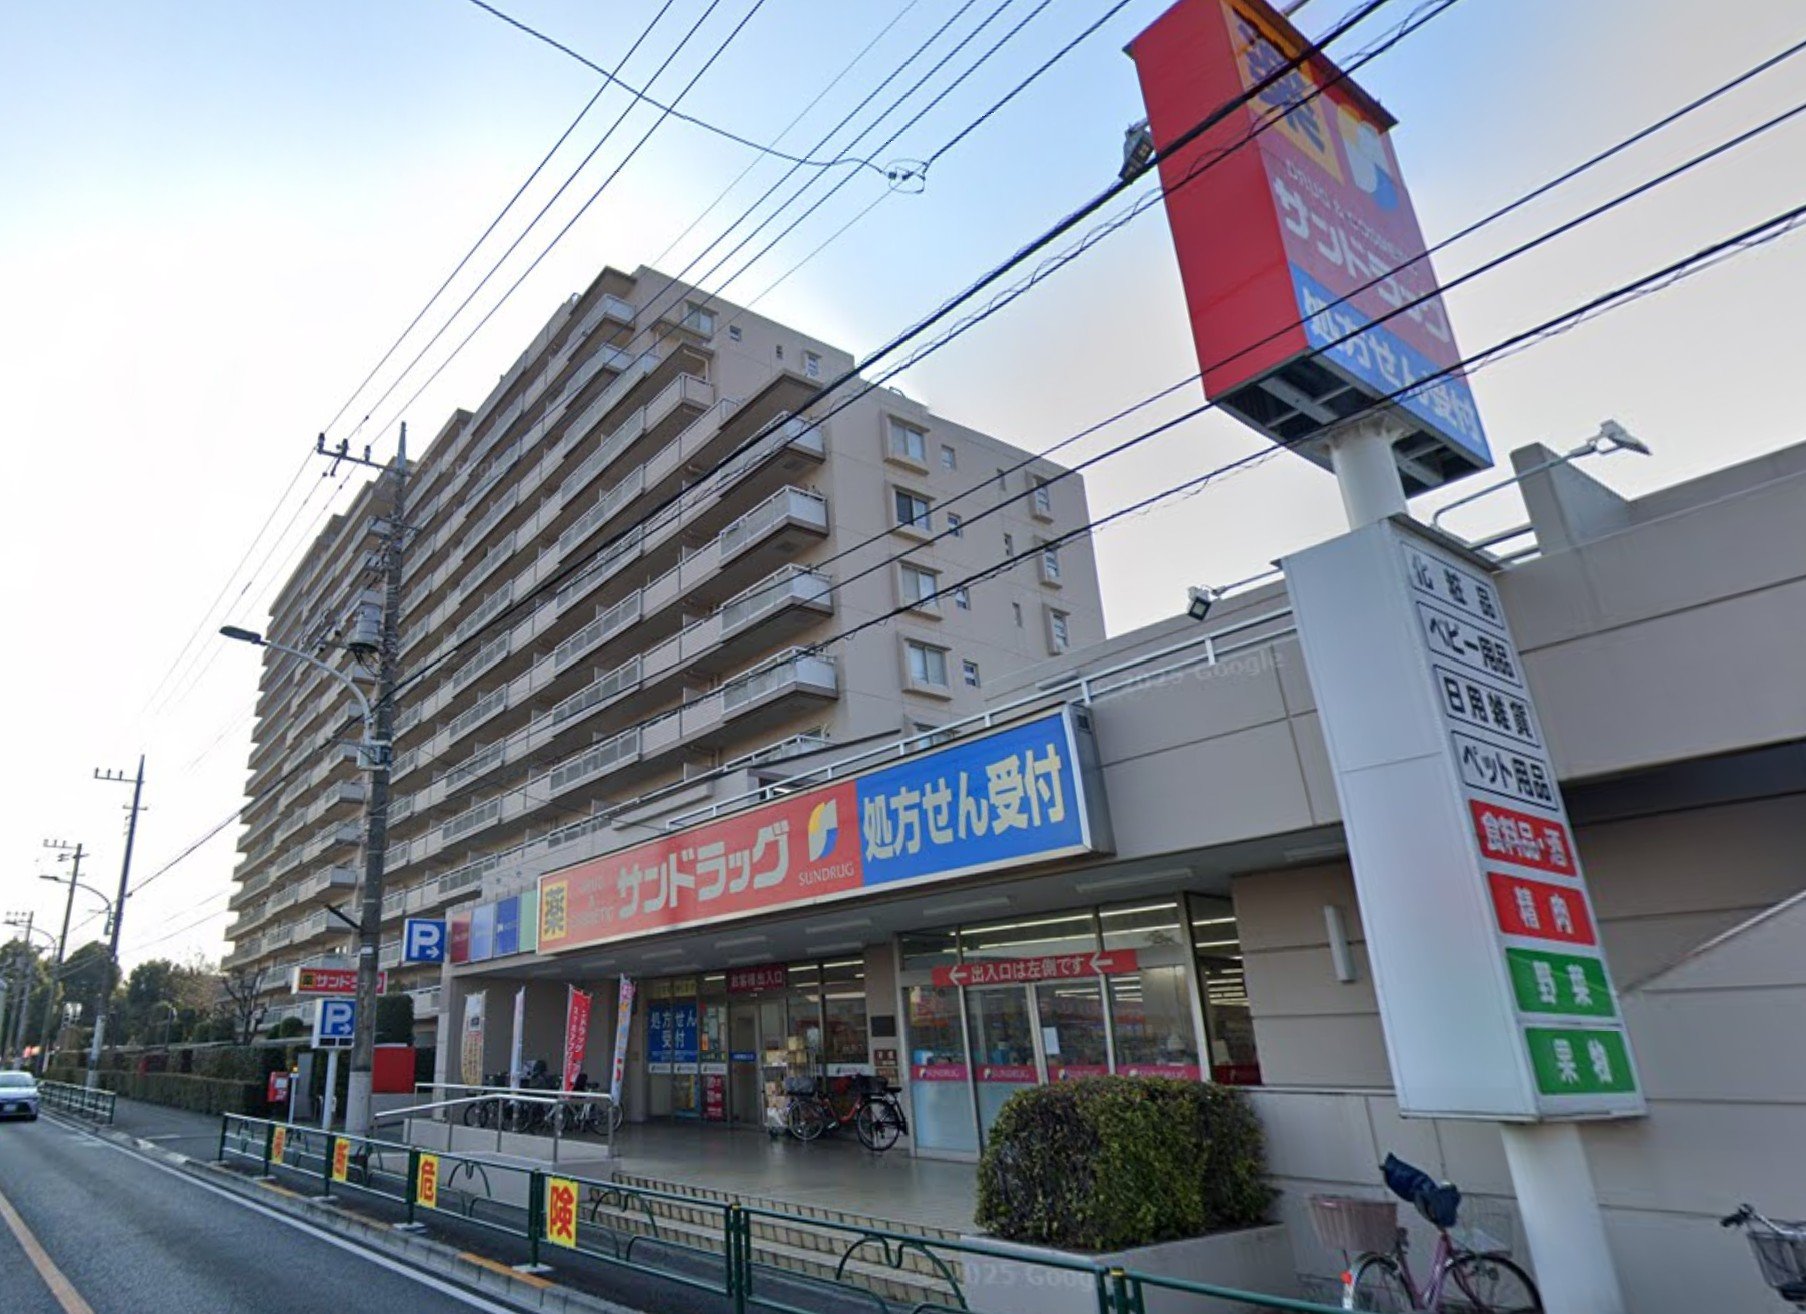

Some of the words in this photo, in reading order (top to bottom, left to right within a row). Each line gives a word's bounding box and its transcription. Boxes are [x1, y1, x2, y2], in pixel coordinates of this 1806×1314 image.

[1272, 174, 1451, 343] サンドラッグ
[1429, 616, 1515, 679] ベビー用品
[1462, 744, 1552, 801] ペット用品
[862, 743, 1066, 863] 処方せん受付
[616, 819, 790, 920] サンドラッグ
[798, 861, 855, 885] SUNDRUG
[544, 885, 565, 936] 薬
[410, 922, 440, 959] P
[970, 956, 1085, 984] 出入口は左側です
[324, 1000, 353, 1034] P
[650, 1009, 698, 1030] 処方せん
[419, 1159, 436, 1201] 危
[550, 1184, 574, 1240] 険
